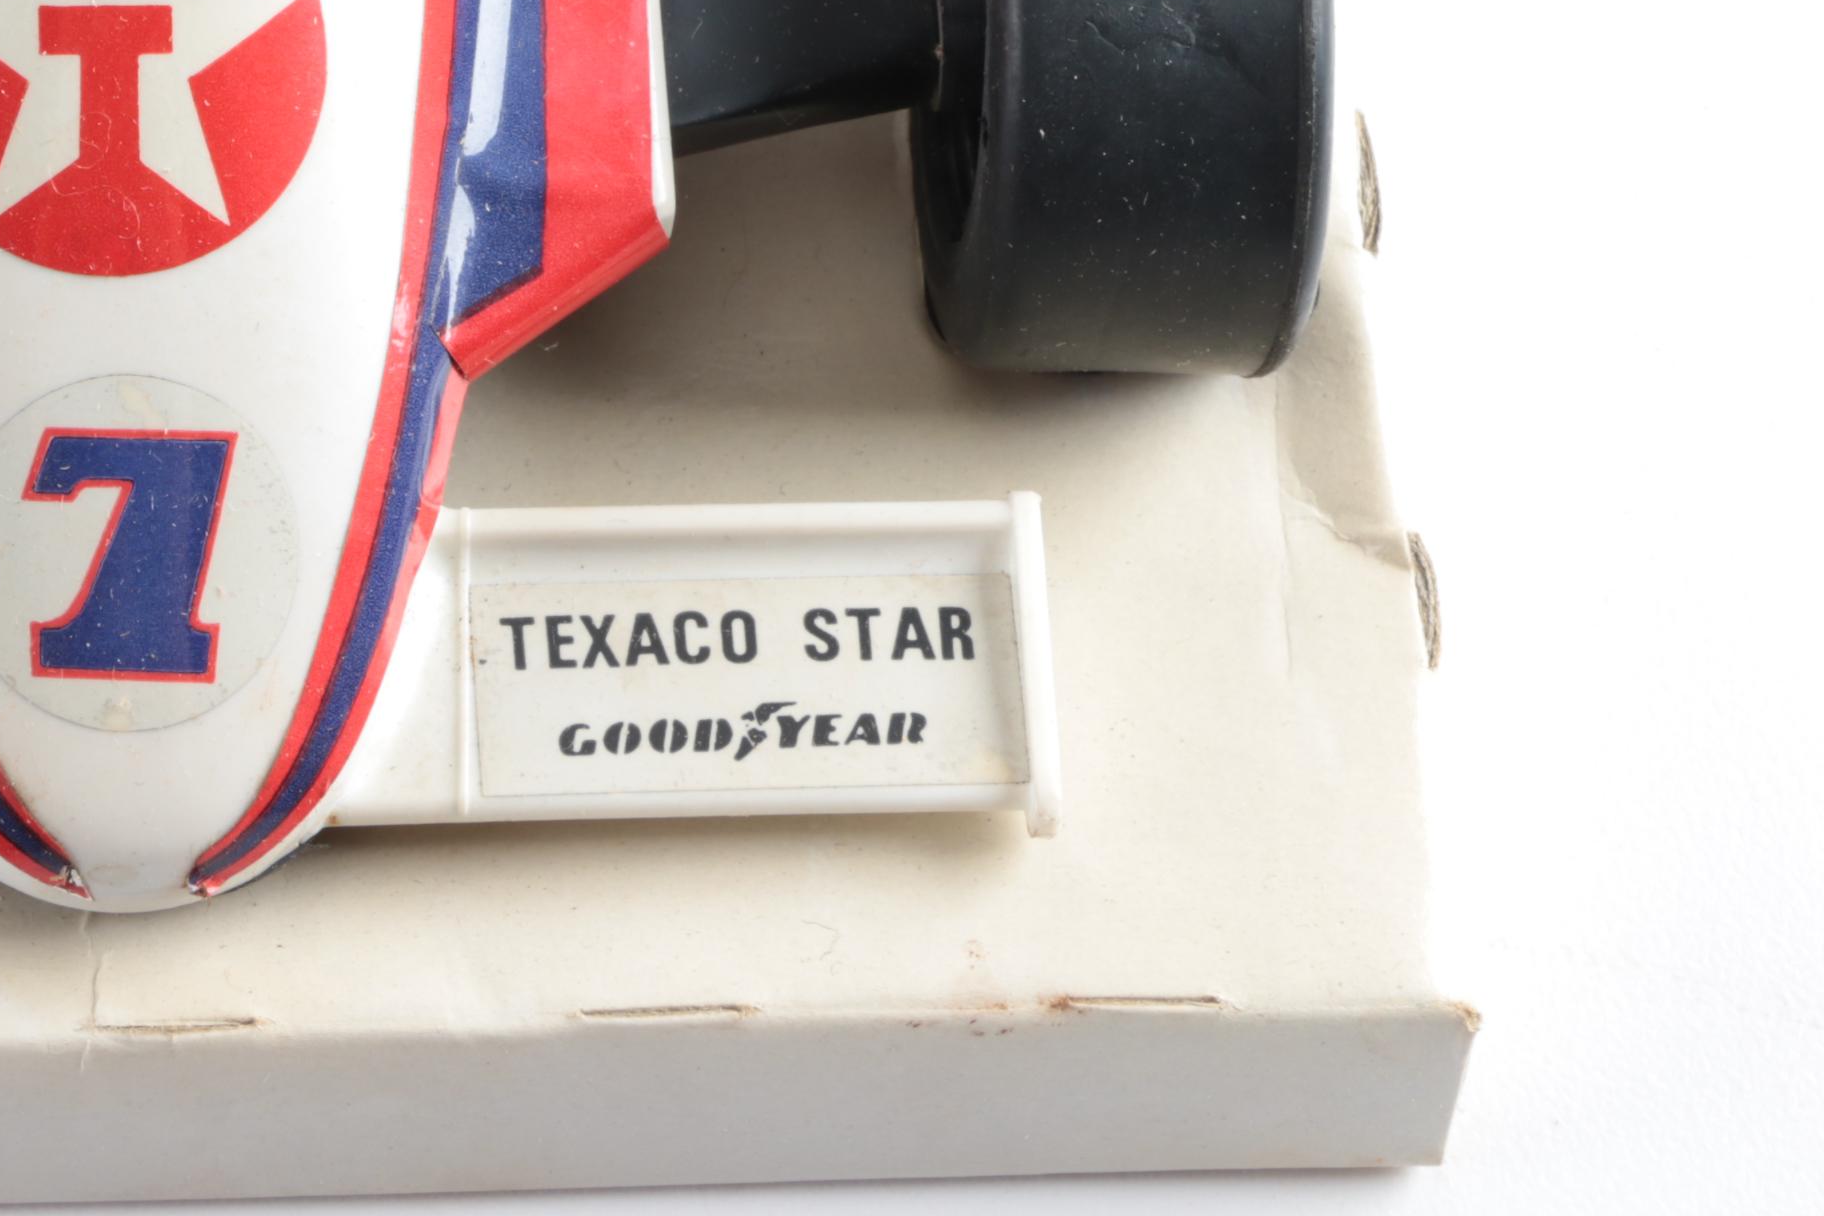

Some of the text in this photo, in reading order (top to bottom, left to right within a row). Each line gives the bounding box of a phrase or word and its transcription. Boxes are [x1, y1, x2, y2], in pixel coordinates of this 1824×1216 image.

[22, 427, 238, 680] 7
[500, 607, 976, 670] TEXACO STAR
[558, 701, 928, 761] GOODYEAR
